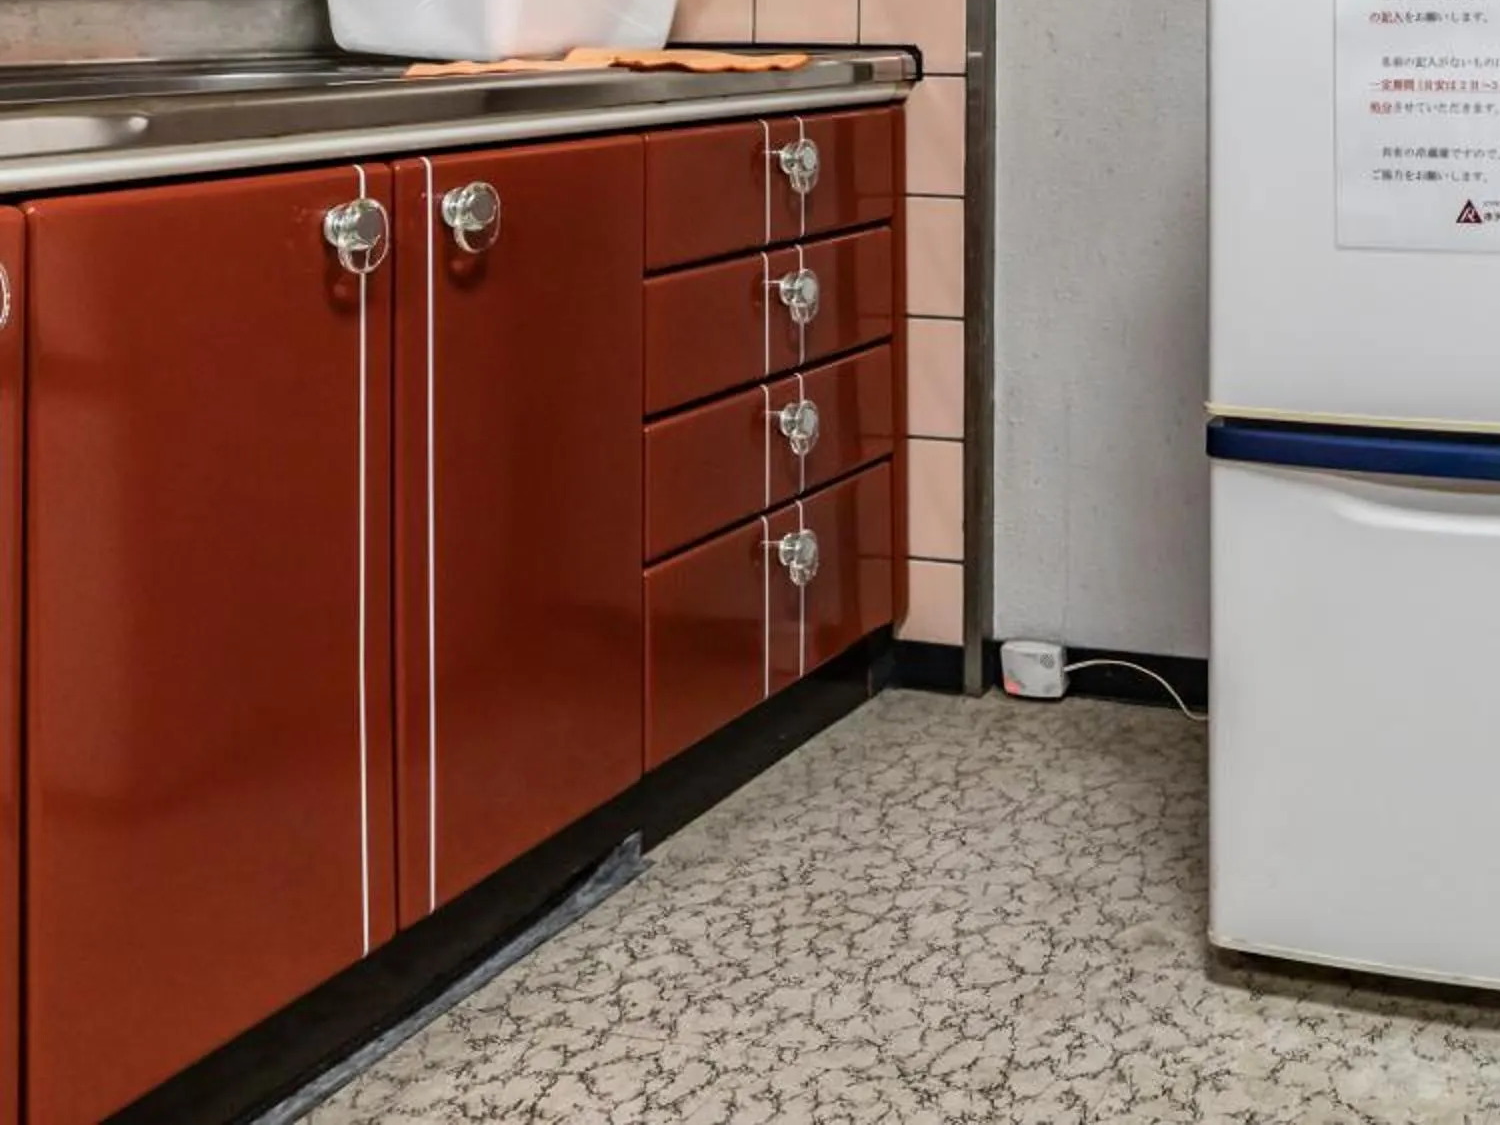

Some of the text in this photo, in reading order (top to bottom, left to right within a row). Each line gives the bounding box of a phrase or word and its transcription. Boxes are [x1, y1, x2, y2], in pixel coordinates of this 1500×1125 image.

[1369, 11, 1489, 24] の記入をお願いします。
